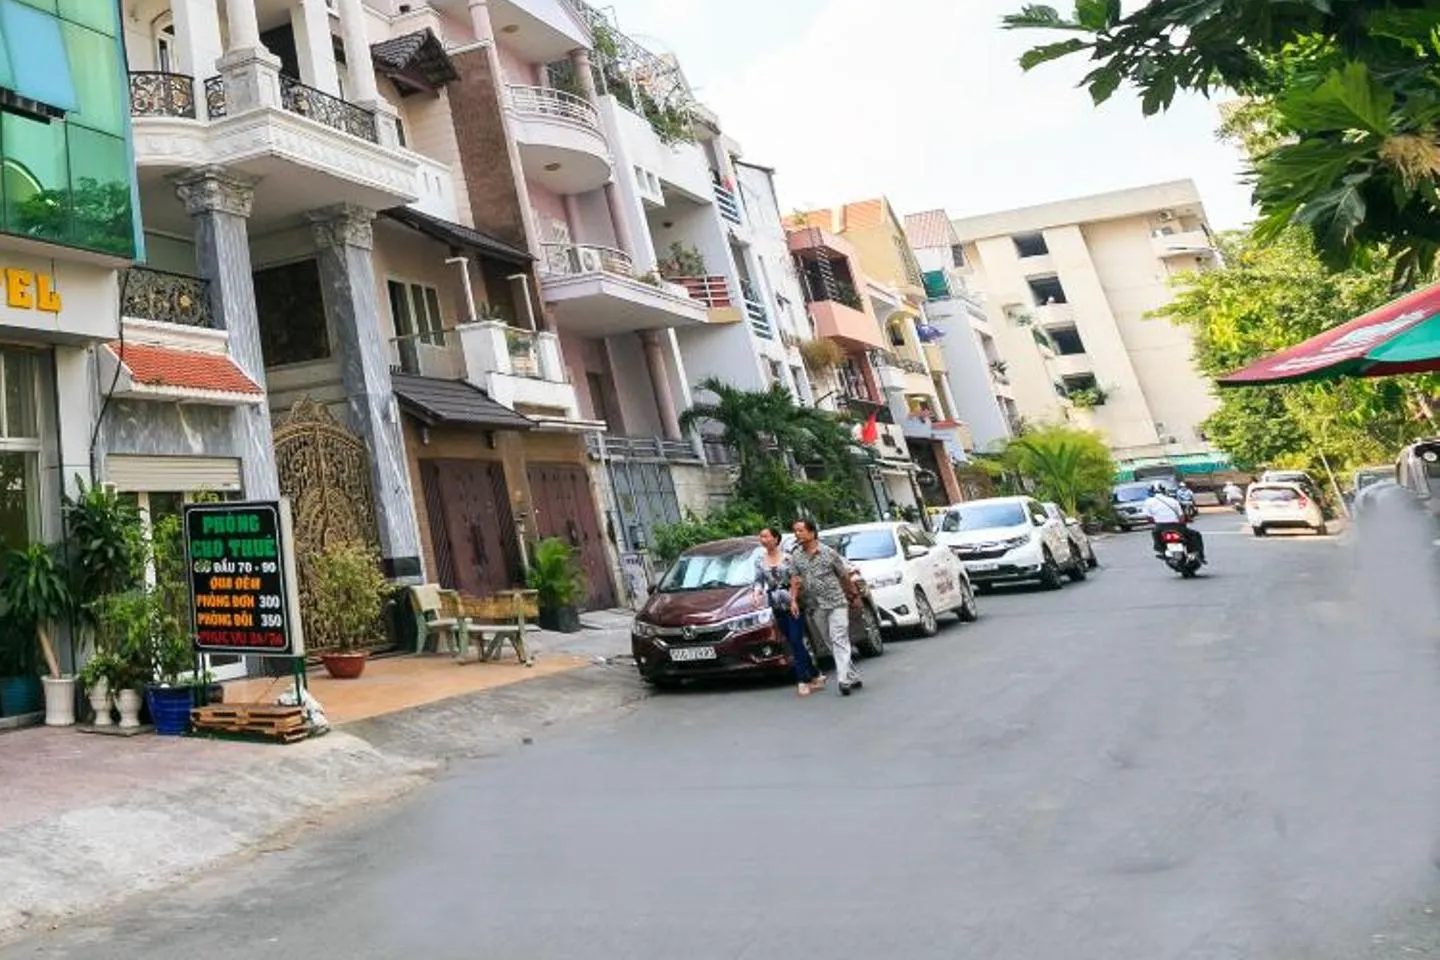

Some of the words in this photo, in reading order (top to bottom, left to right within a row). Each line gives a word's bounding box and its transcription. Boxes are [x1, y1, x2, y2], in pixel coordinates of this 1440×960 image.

[202, 512, 260, 533] PHÒNG
[191, 539, 224, 557] CHO
[237, 561, 252, 573] 70
[259, 594, 280, 608] 300
[261, 613, 283, 628] 350
